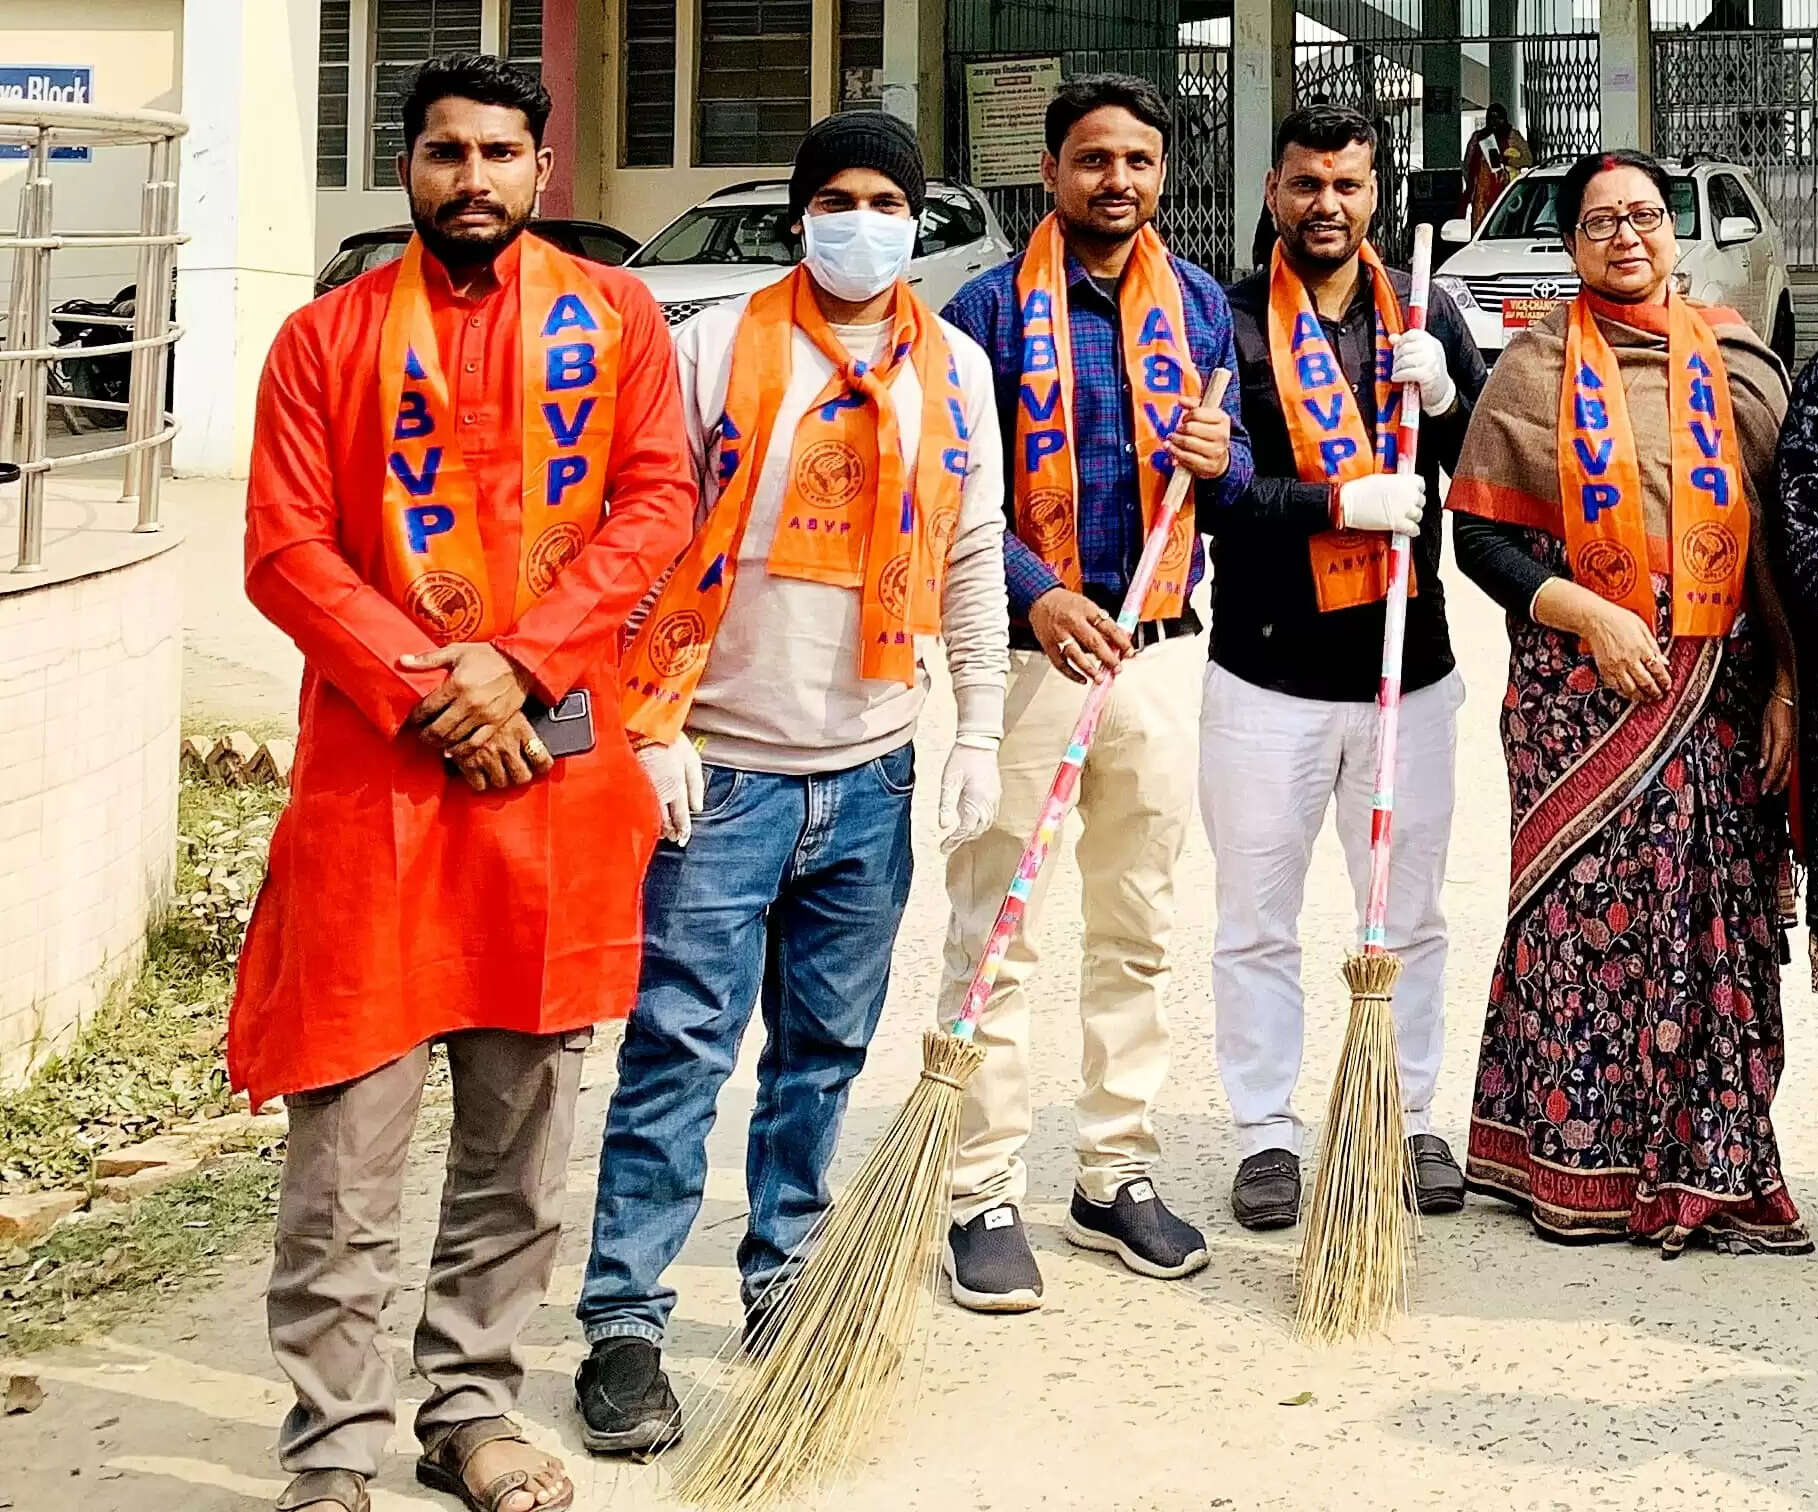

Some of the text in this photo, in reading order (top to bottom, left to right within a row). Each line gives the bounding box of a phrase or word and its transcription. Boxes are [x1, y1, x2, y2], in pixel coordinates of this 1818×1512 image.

[540, 293, 600, 506] ABVP
[1018, 288, 1068, 473] ABVP
[1290, 311, 1357, 479] ABVP
[1572, 359, 1621, 525] ABVP
[788, 516, 851, 534] ABVP
